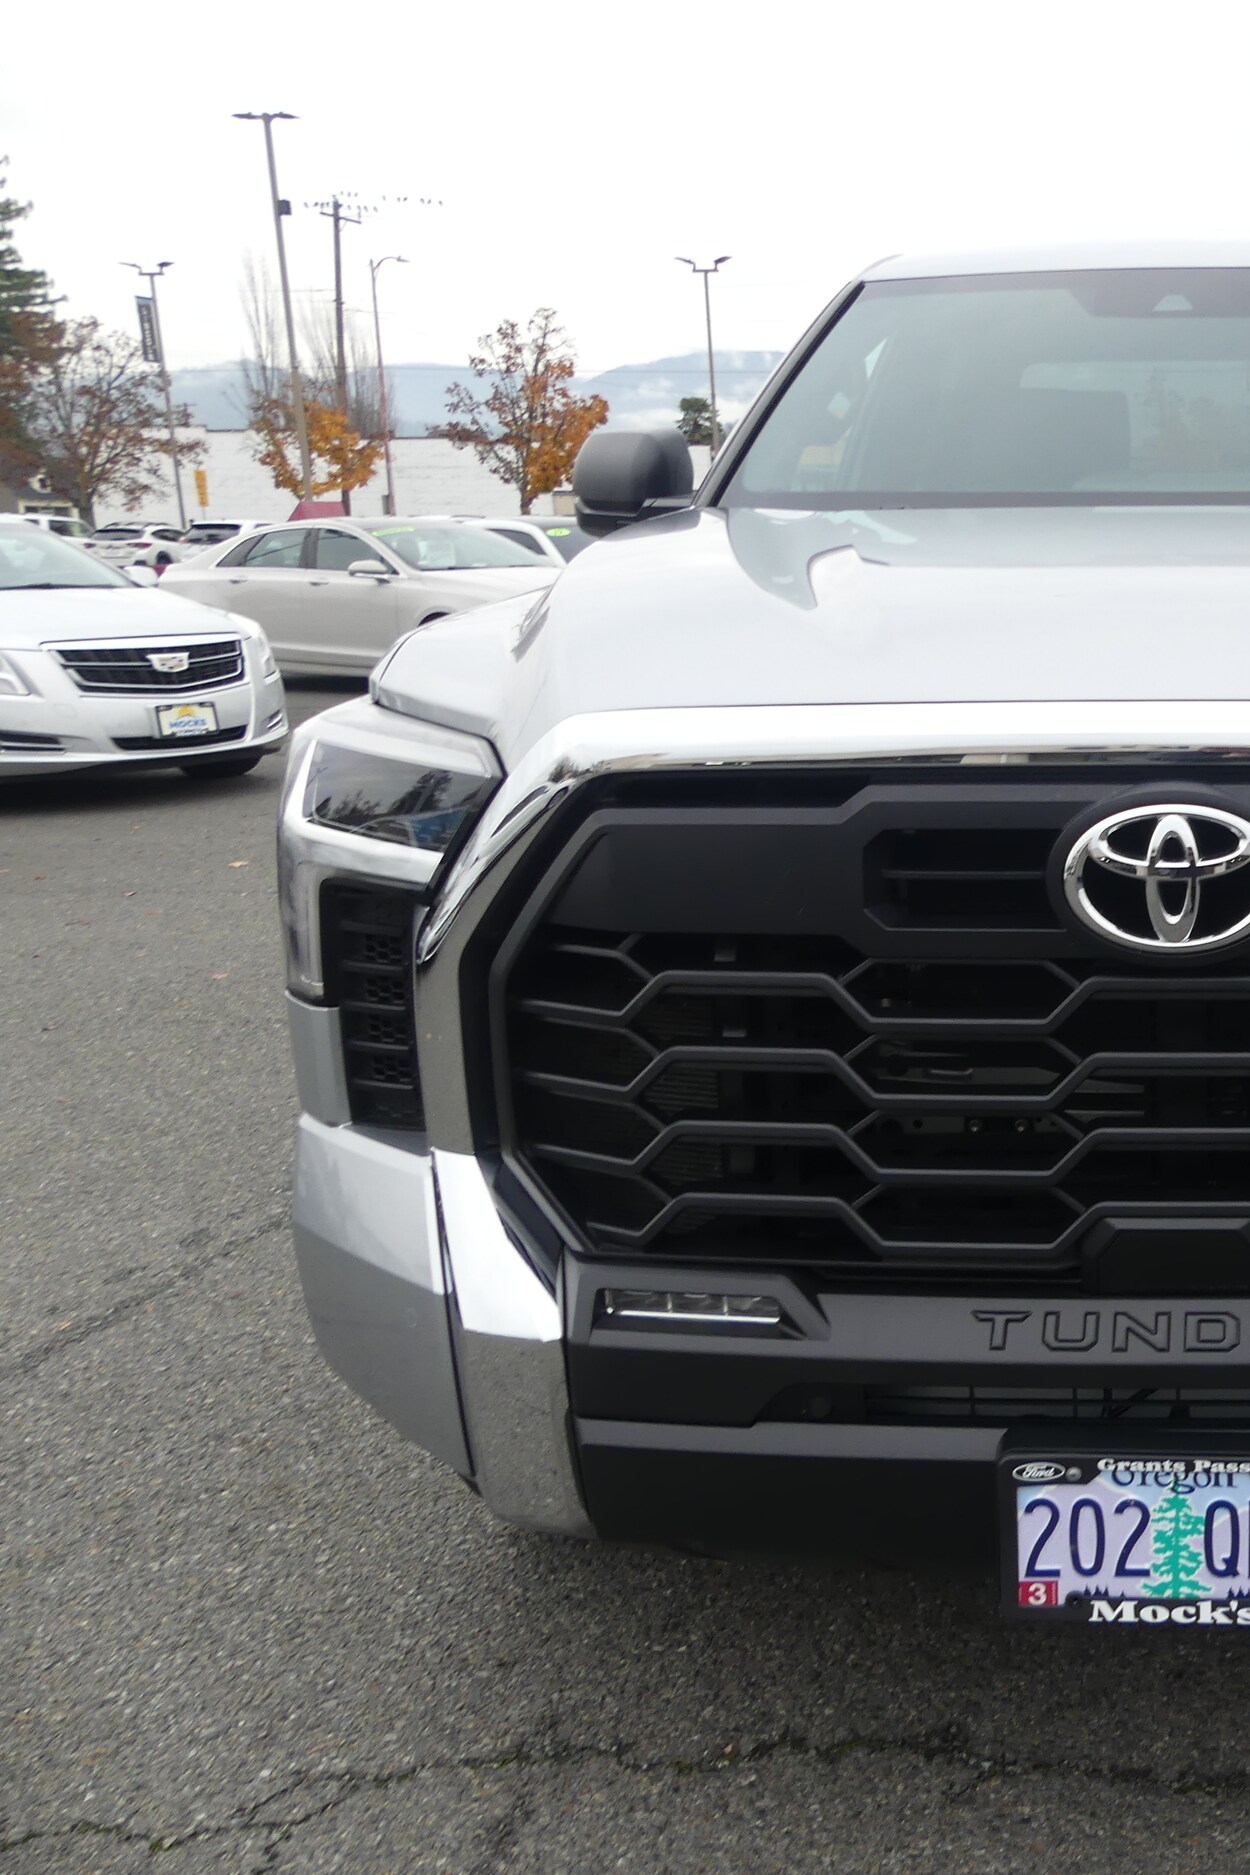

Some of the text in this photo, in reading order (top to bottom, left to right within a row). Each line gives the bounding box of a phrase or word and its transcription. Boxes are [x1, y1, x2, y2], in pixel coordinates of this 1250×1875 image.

[1097, 1458, 1187, 1473] Grants
[1111, 1468, 1238, 1494] Oregon
[1023, 1497, 1151, 1578] 202
[1028, 1582, 1048, 1606] 3
